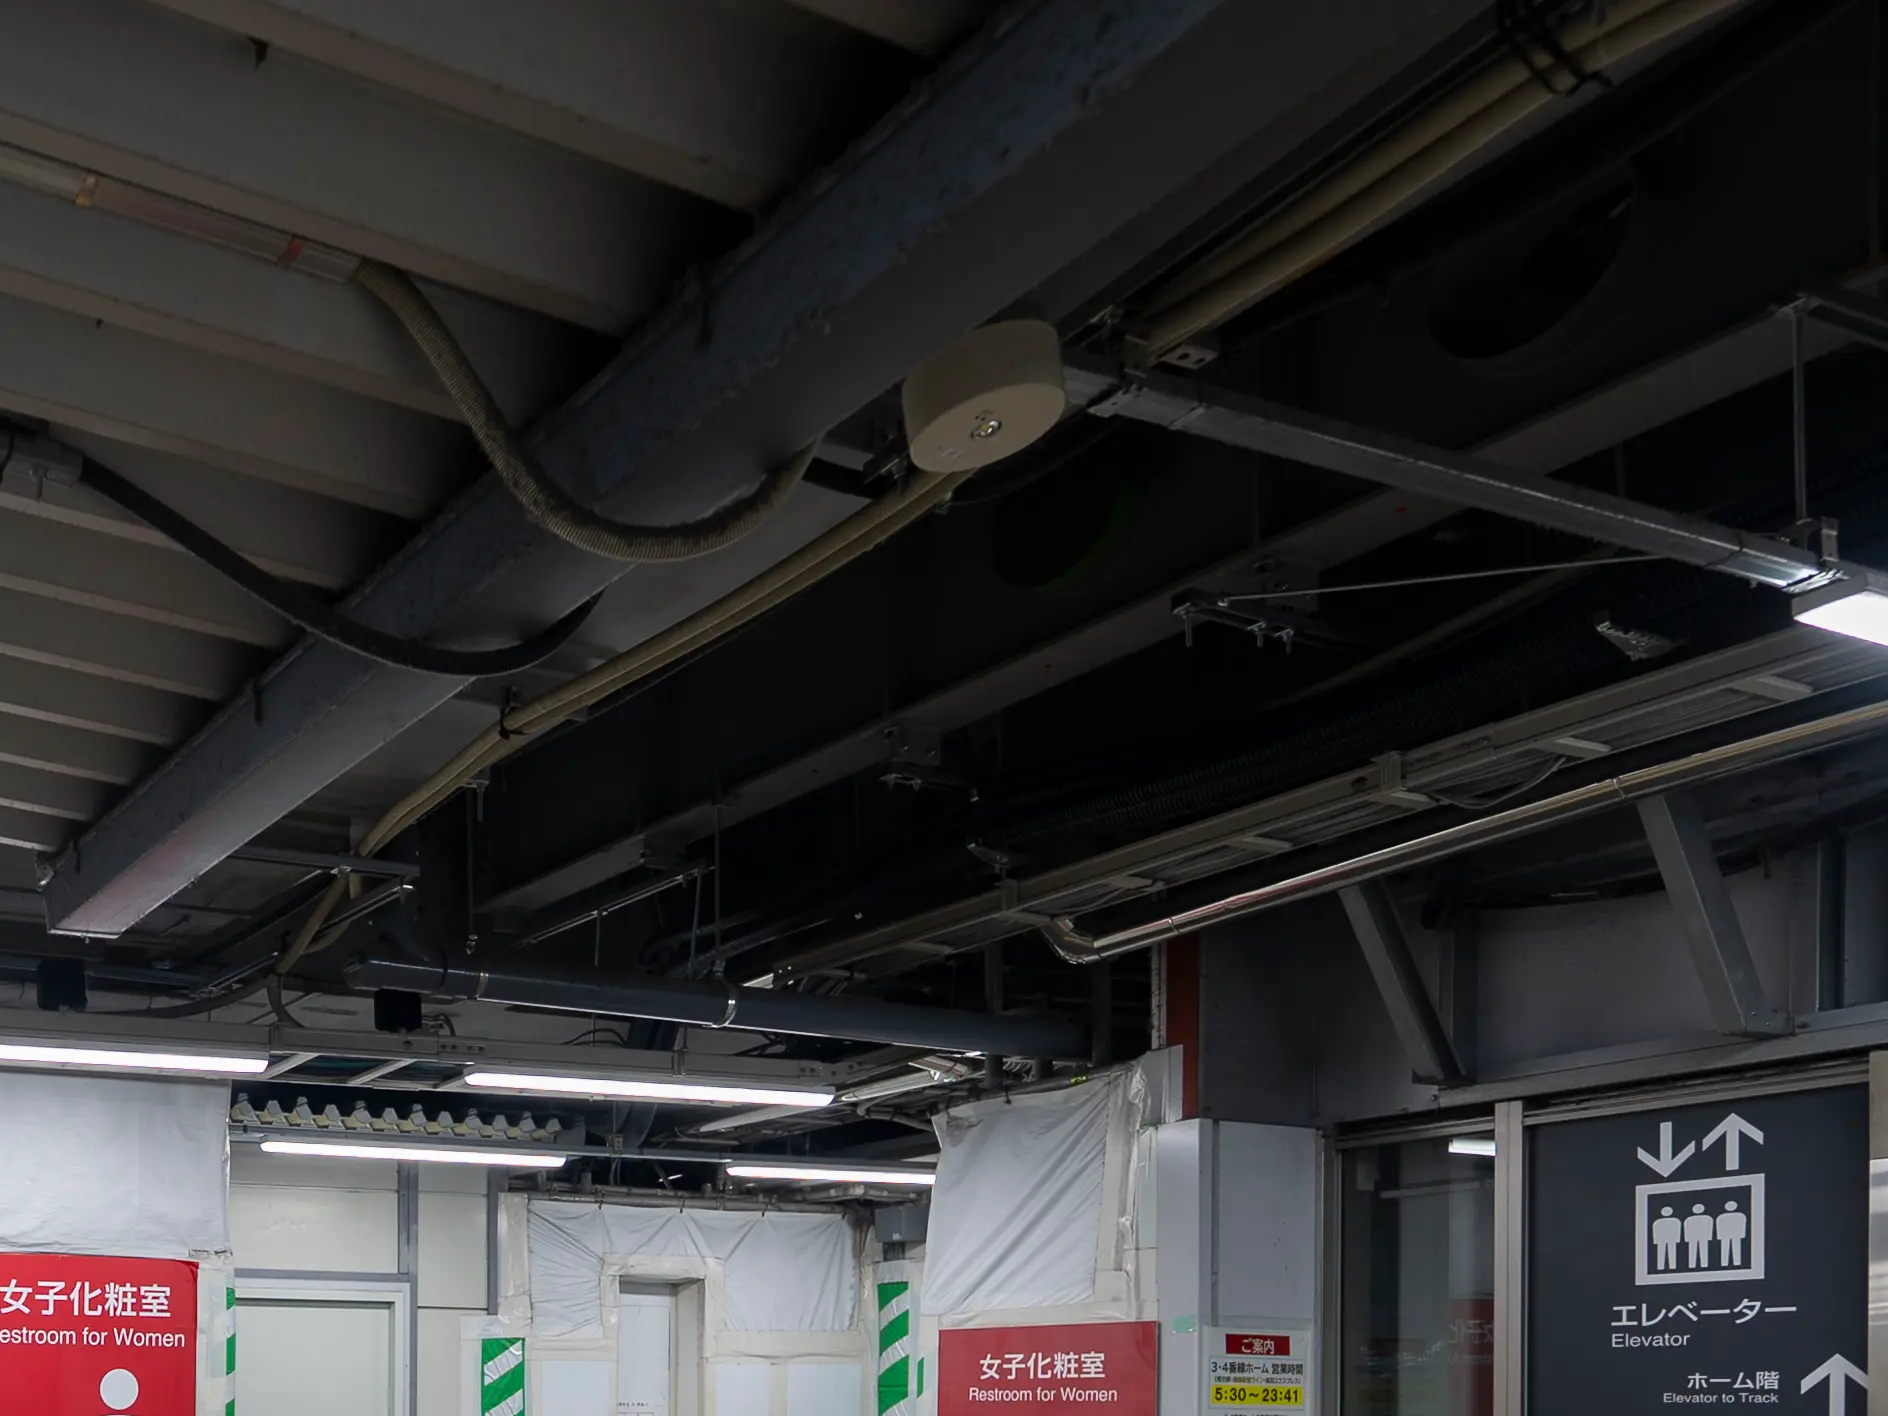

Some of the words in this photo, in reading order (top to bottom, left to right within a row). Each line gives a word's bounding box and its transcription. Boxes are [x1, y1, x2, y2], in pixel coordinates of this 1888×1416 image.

[0, 1278, 172, 1319] 女子化粧室
[1611, 1298, 1797, 1327] エレベーター
[82, 1325, 109, 1347] for
[112, 1327, 186, 1348] Women
[1241, 1338, 1275, 1354] ご案内
[1611, 1332, 1690, 1348] Elevator
[979, 1351, 1106, 1380] 女子化粧室
[1687, 1371, 1780, 1391] ホーム階
[969, 1387, 1032, 1402] Restroom
[1036, 1387, 1057, 1402] for
[1060, 1387, 1118, 1402] Women
[1663, 1392, 1719, 1404] Elevator
[1722, 1392, 1735, 1404] to
[1738, 1391, 1779, 1404] Track
